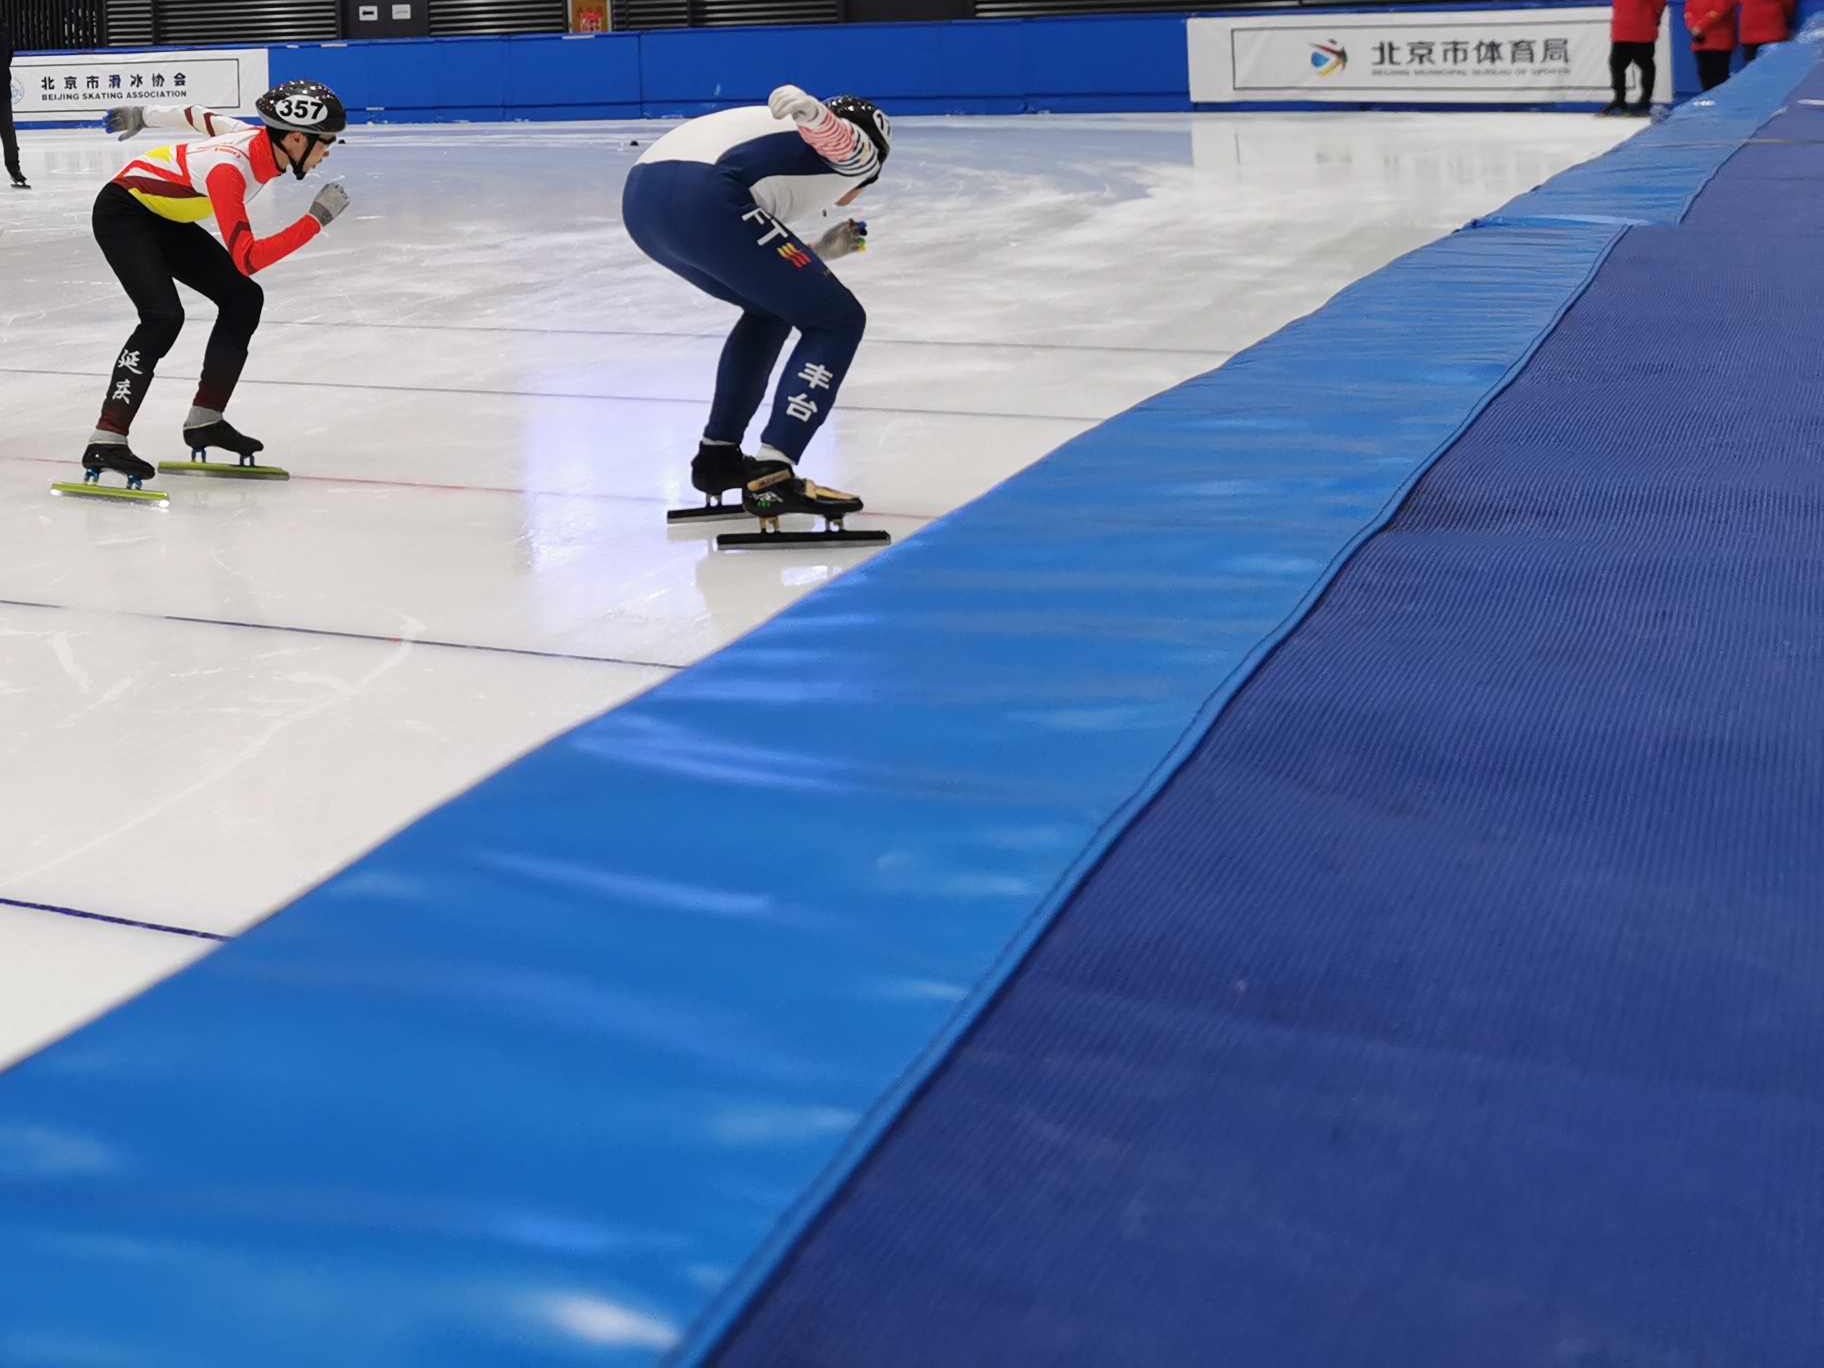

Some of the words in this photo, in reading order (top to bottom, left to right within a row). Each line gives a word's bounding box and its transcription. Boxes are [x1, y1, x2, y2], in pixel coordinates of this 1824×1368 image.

[1371, 38, 1569, 65] 北京市体育局
[41, 72, 186, 90] 北京市滑冰协会
[42, 93, 79, 101] BEIJING
[82, 92, 123, 100] SKATING
[126, 90, 187, 99] ASSOCIATION
[279, 98, 323, 120] 357
[786, 362, 833, 423] 丰台
